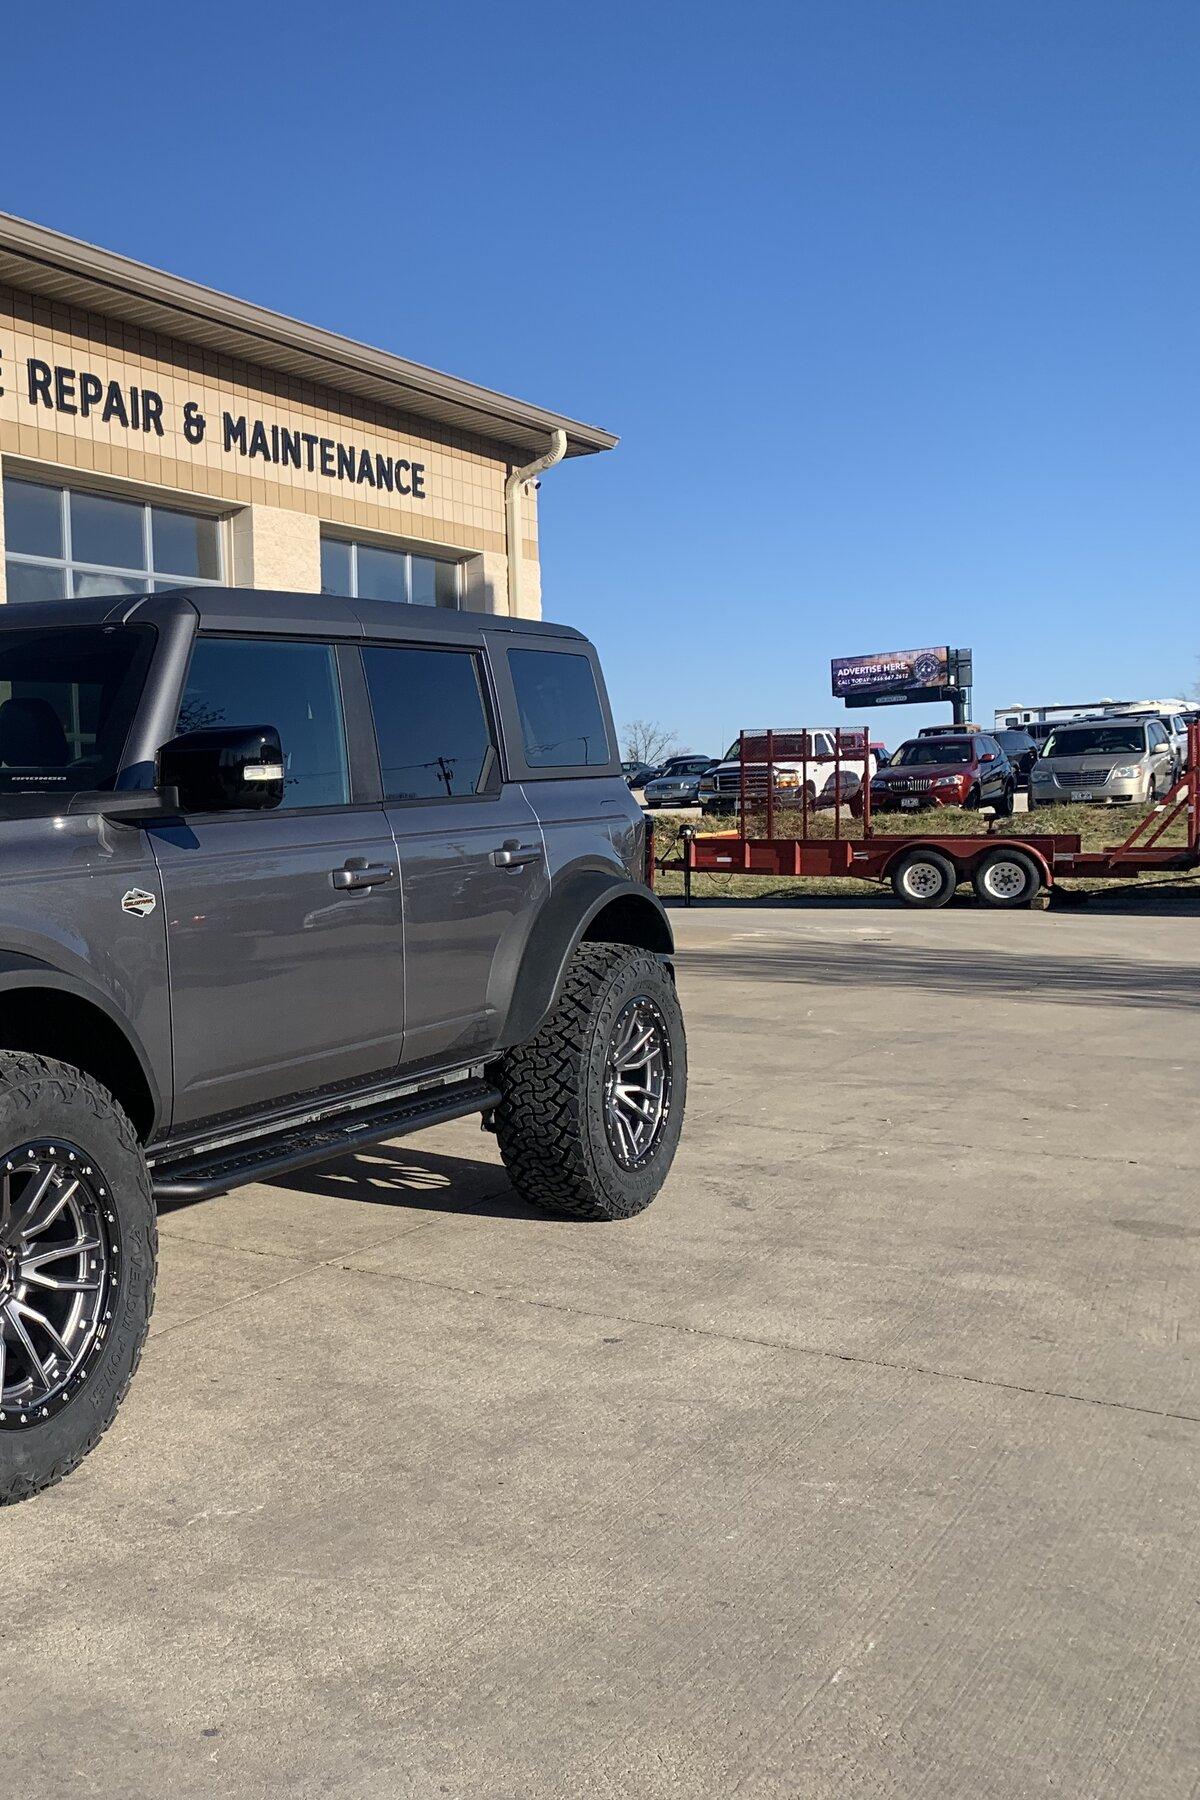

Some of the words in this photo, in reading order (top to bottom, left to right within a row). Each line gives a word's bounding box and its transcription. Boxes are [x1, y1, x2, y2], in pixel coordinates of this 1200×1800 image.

[27, 358, 164, 437] REPAIR
[183, 401, 206, 445] &
[222, 411, 426, 499] MAINTENANCE
[837, 665, 882, 677] ADVERTISE
